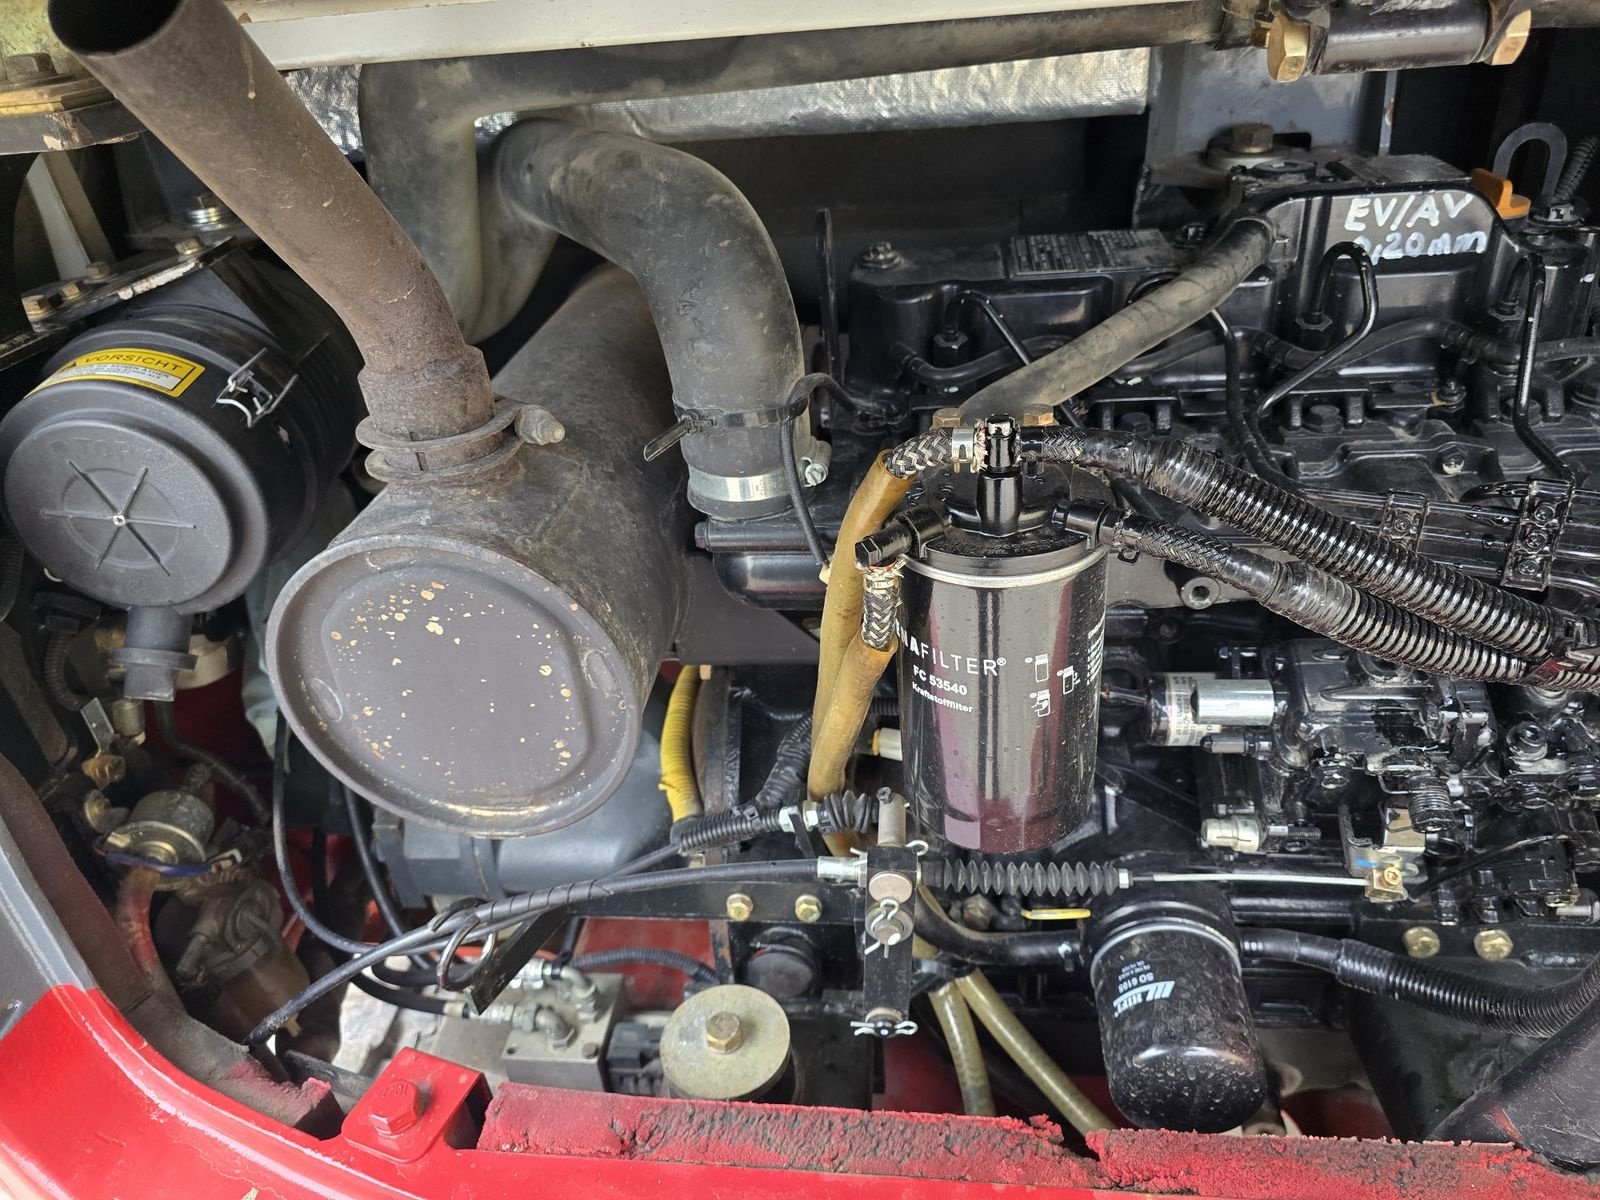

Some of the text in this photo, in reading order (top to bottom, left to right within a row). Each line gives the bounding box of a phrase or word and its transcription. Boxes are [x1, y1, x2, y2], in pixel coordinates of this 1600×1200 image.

[1344, 193, 1474, 231] EV/AV
[85, 354, 182, 371] VORSICHT
[913, 664, 967, 696] FC 53540
[1138, 972, 1154, 984] SO
